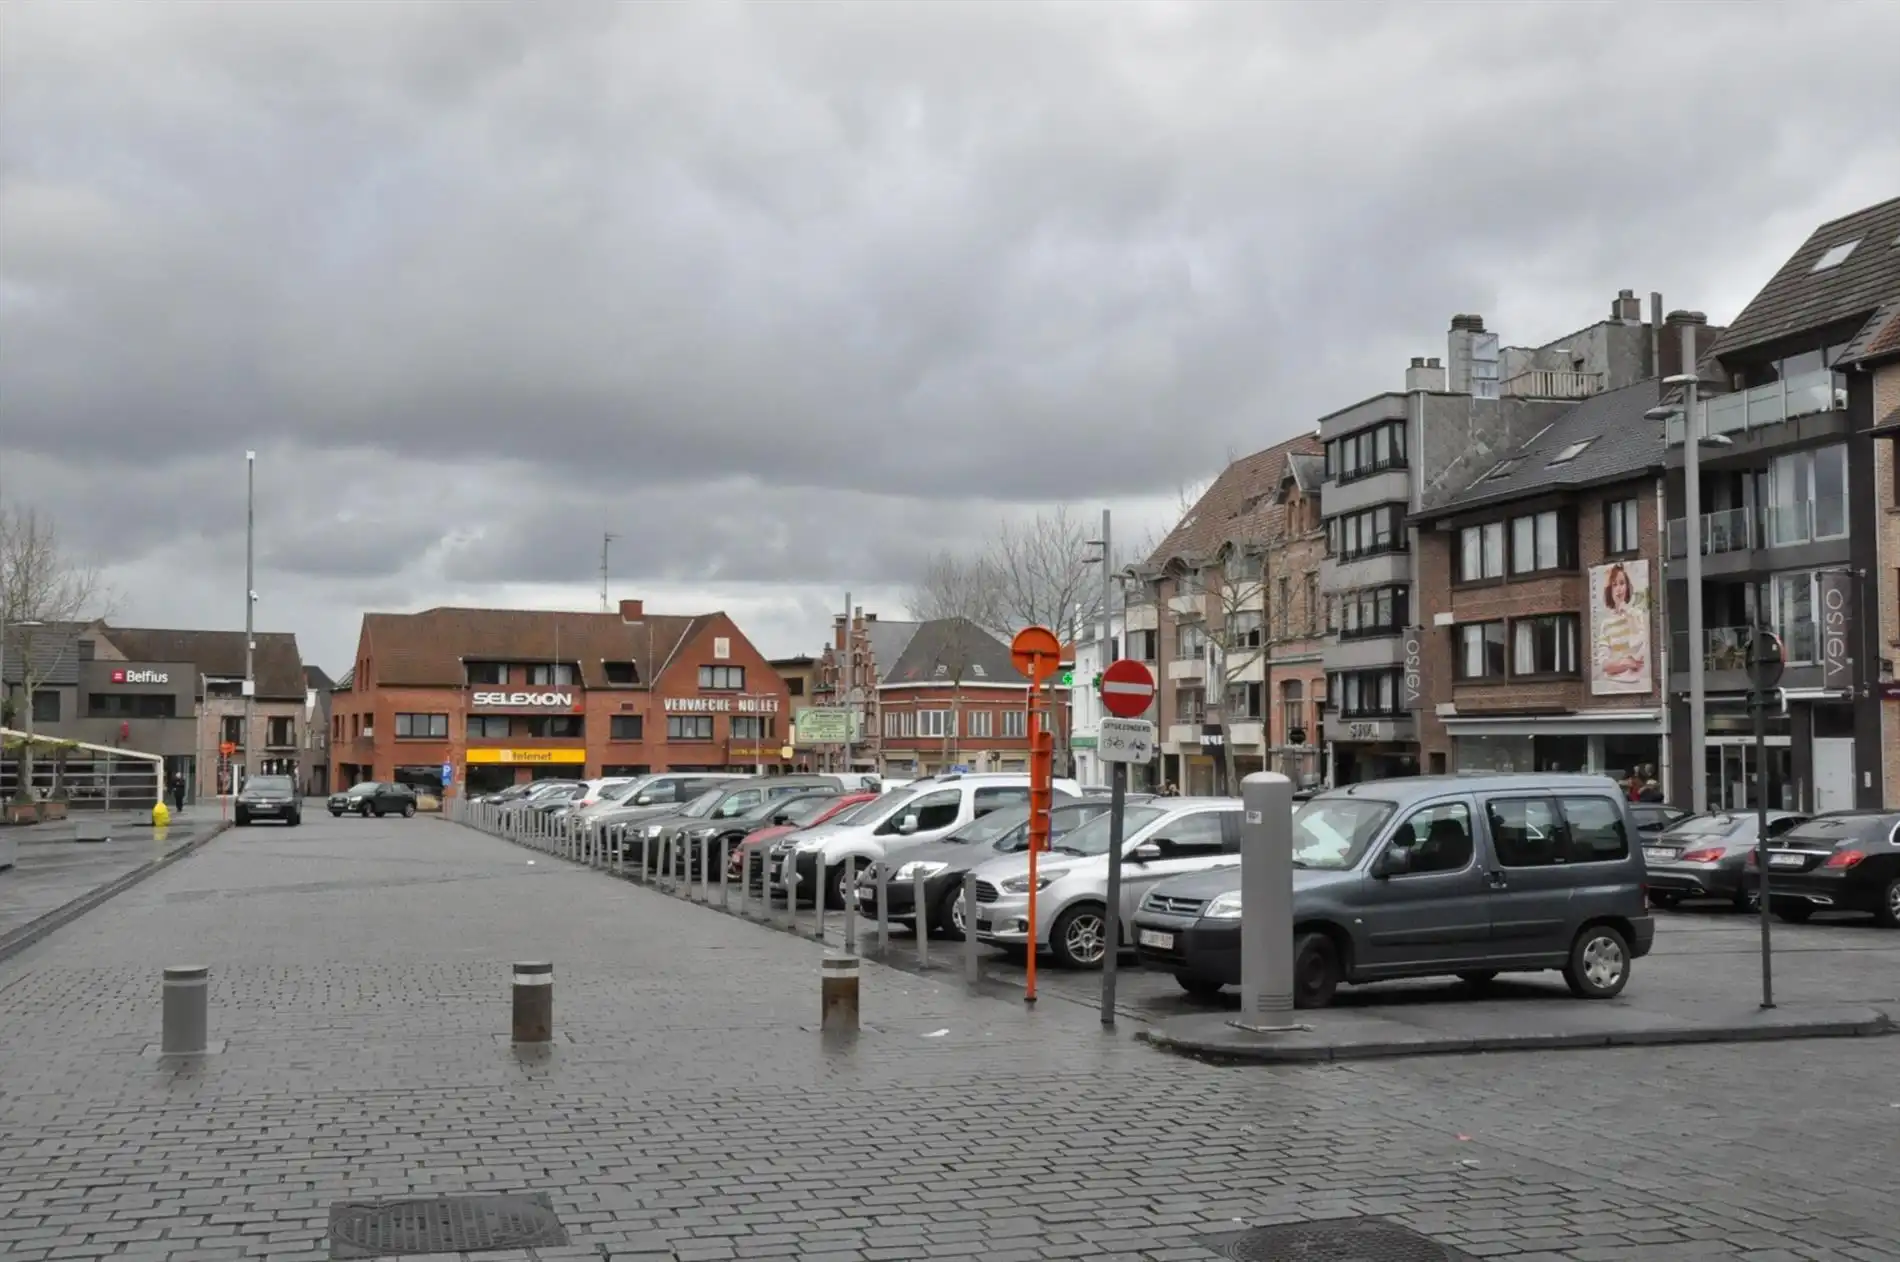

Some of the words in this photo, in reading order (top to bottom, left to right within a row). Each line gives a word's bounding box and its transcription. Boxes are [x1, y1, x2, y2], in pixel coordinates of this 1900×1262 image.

[1826, 588, 1844, 676] verso
[126, 670, 168, 683] Belfius
[1406, 639, 1420, 701] verso
[473, 692, 572, 706] SELEXION
